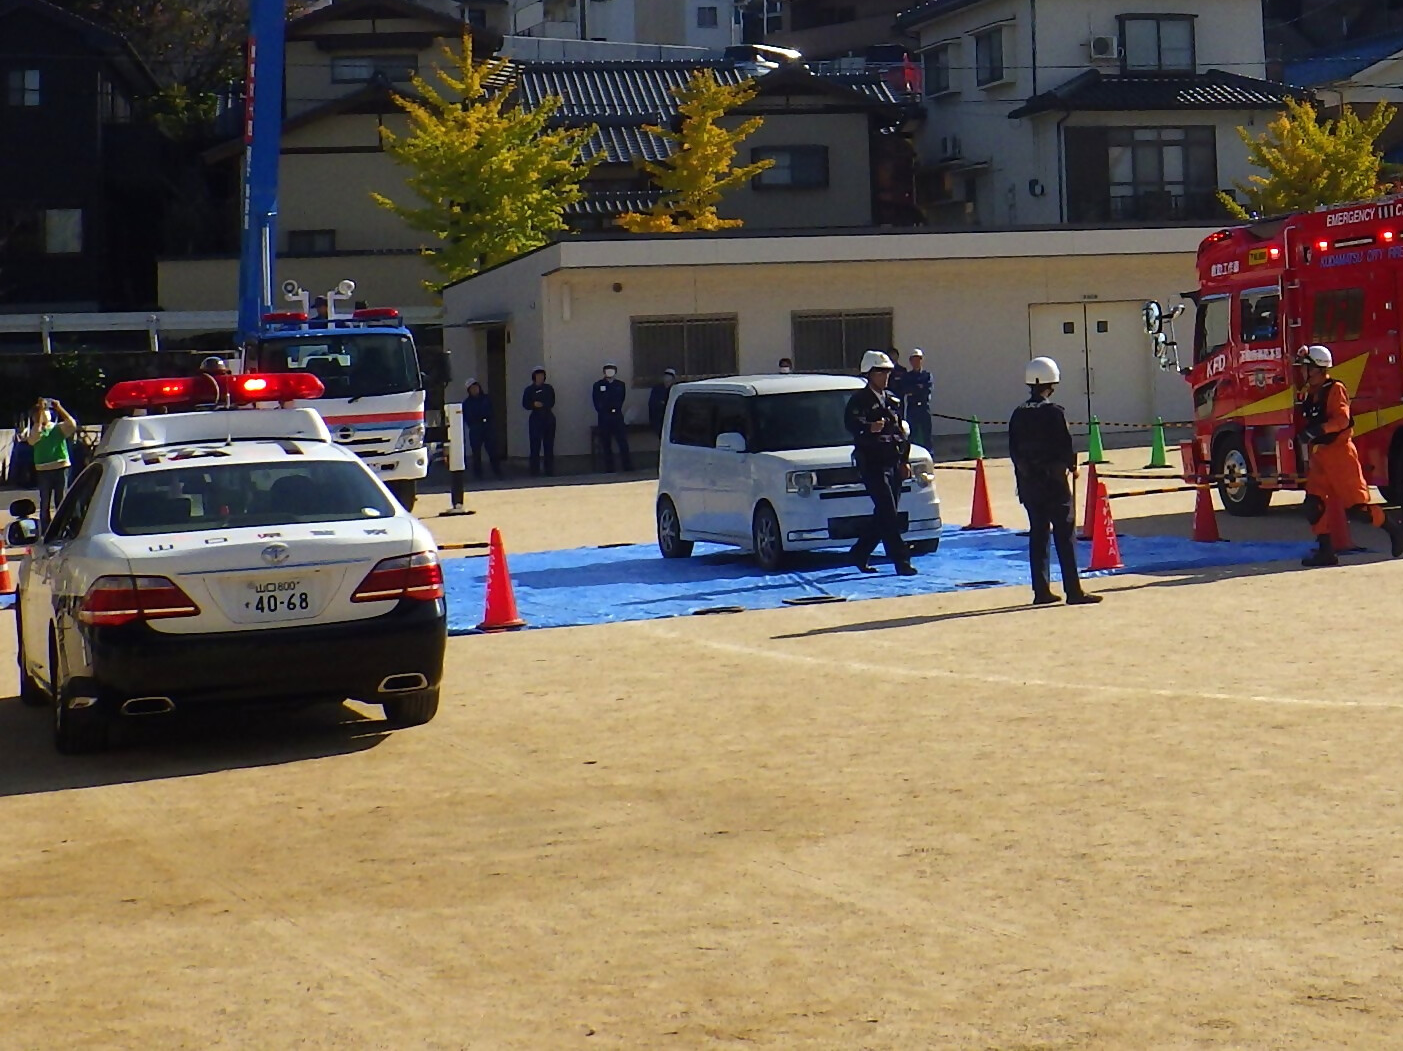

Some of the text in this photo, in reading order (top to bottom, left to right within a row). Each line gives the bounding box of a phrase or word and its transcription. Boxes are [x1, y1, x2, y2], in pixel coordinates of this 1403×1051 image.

[1326, 207, 1377, 228] EMERGENCY
[1206, 354, 1226, 378] KFD
[255, 592, 309, 613] 40-68
